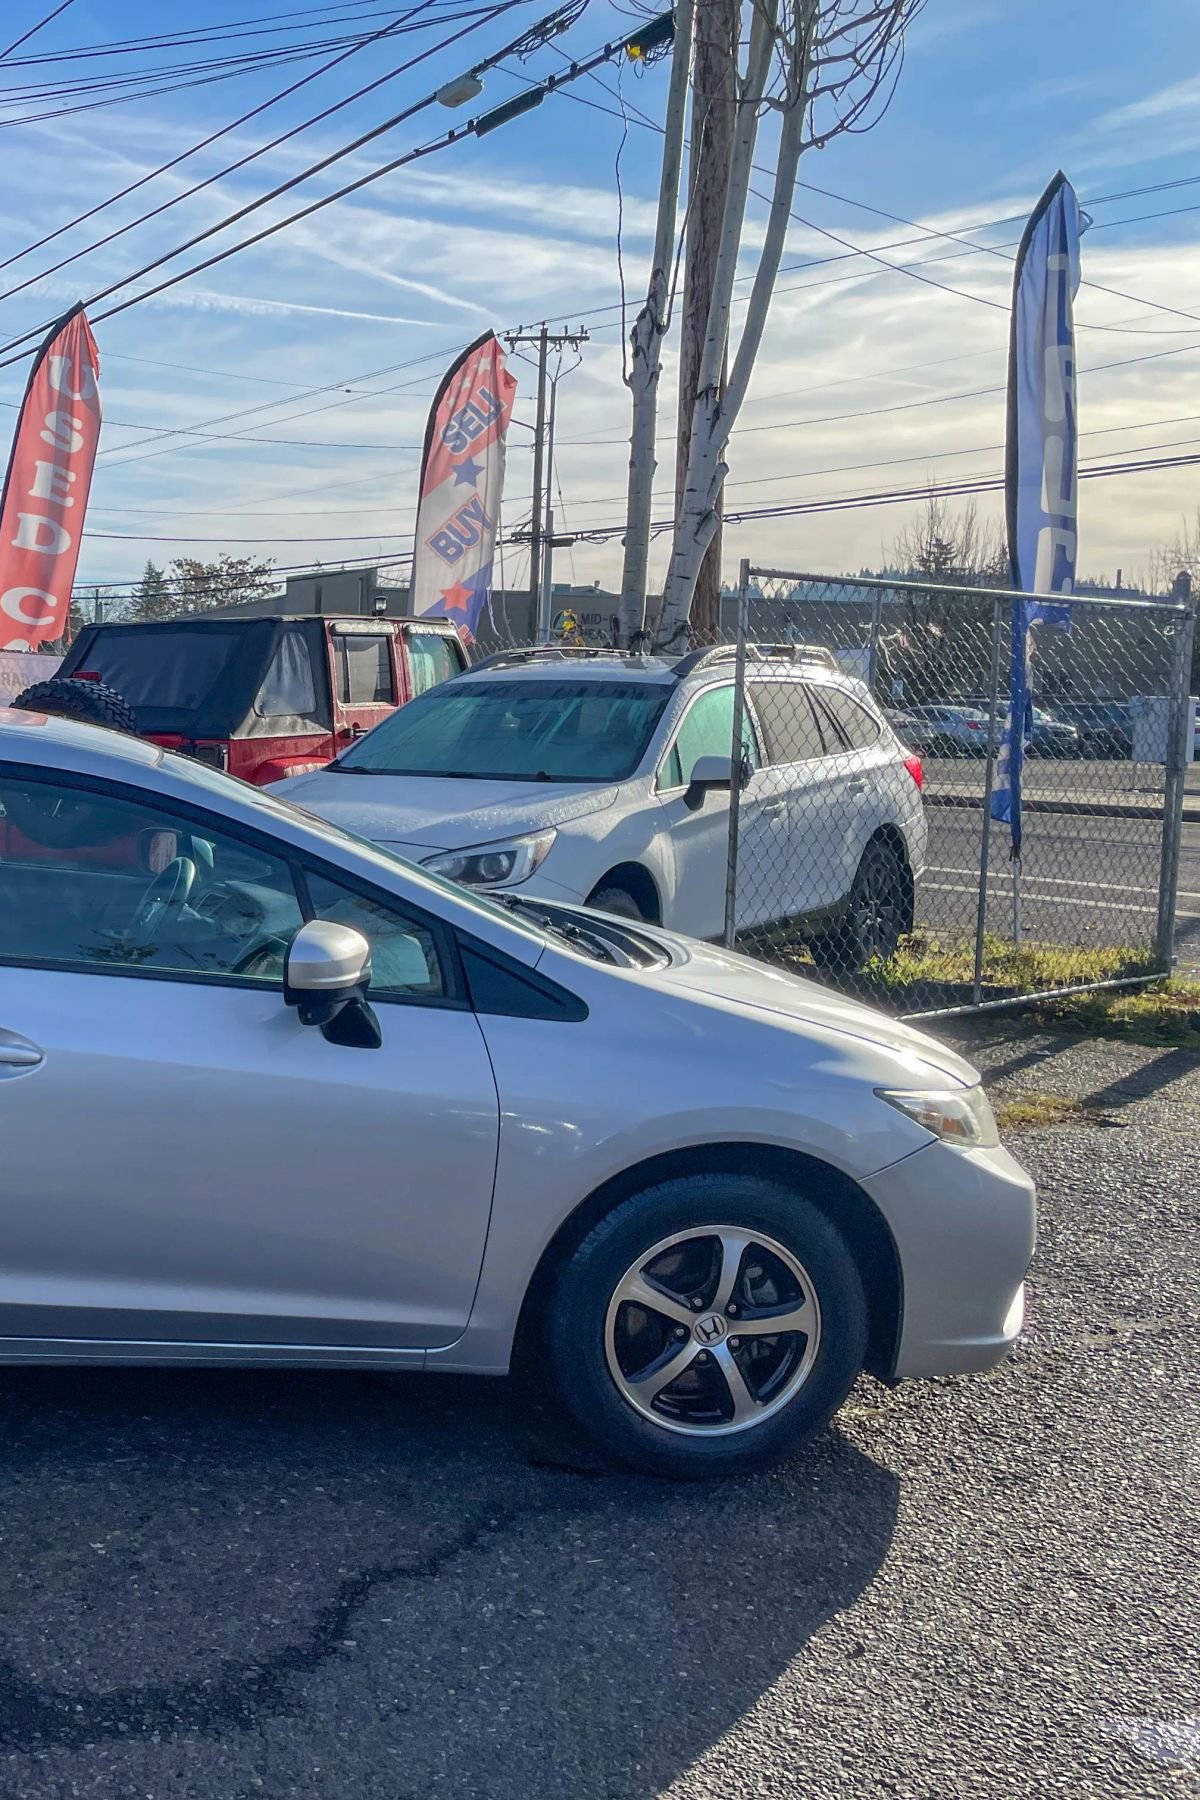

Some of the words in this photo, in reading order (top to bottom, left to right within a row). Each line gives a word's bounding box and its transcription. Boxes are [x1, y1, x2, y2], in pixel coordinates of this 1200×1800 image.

[11, 355, 96, 554] USED
[440, 386, 507, 456] SELL
[428, 495, 493, 566] BUY
